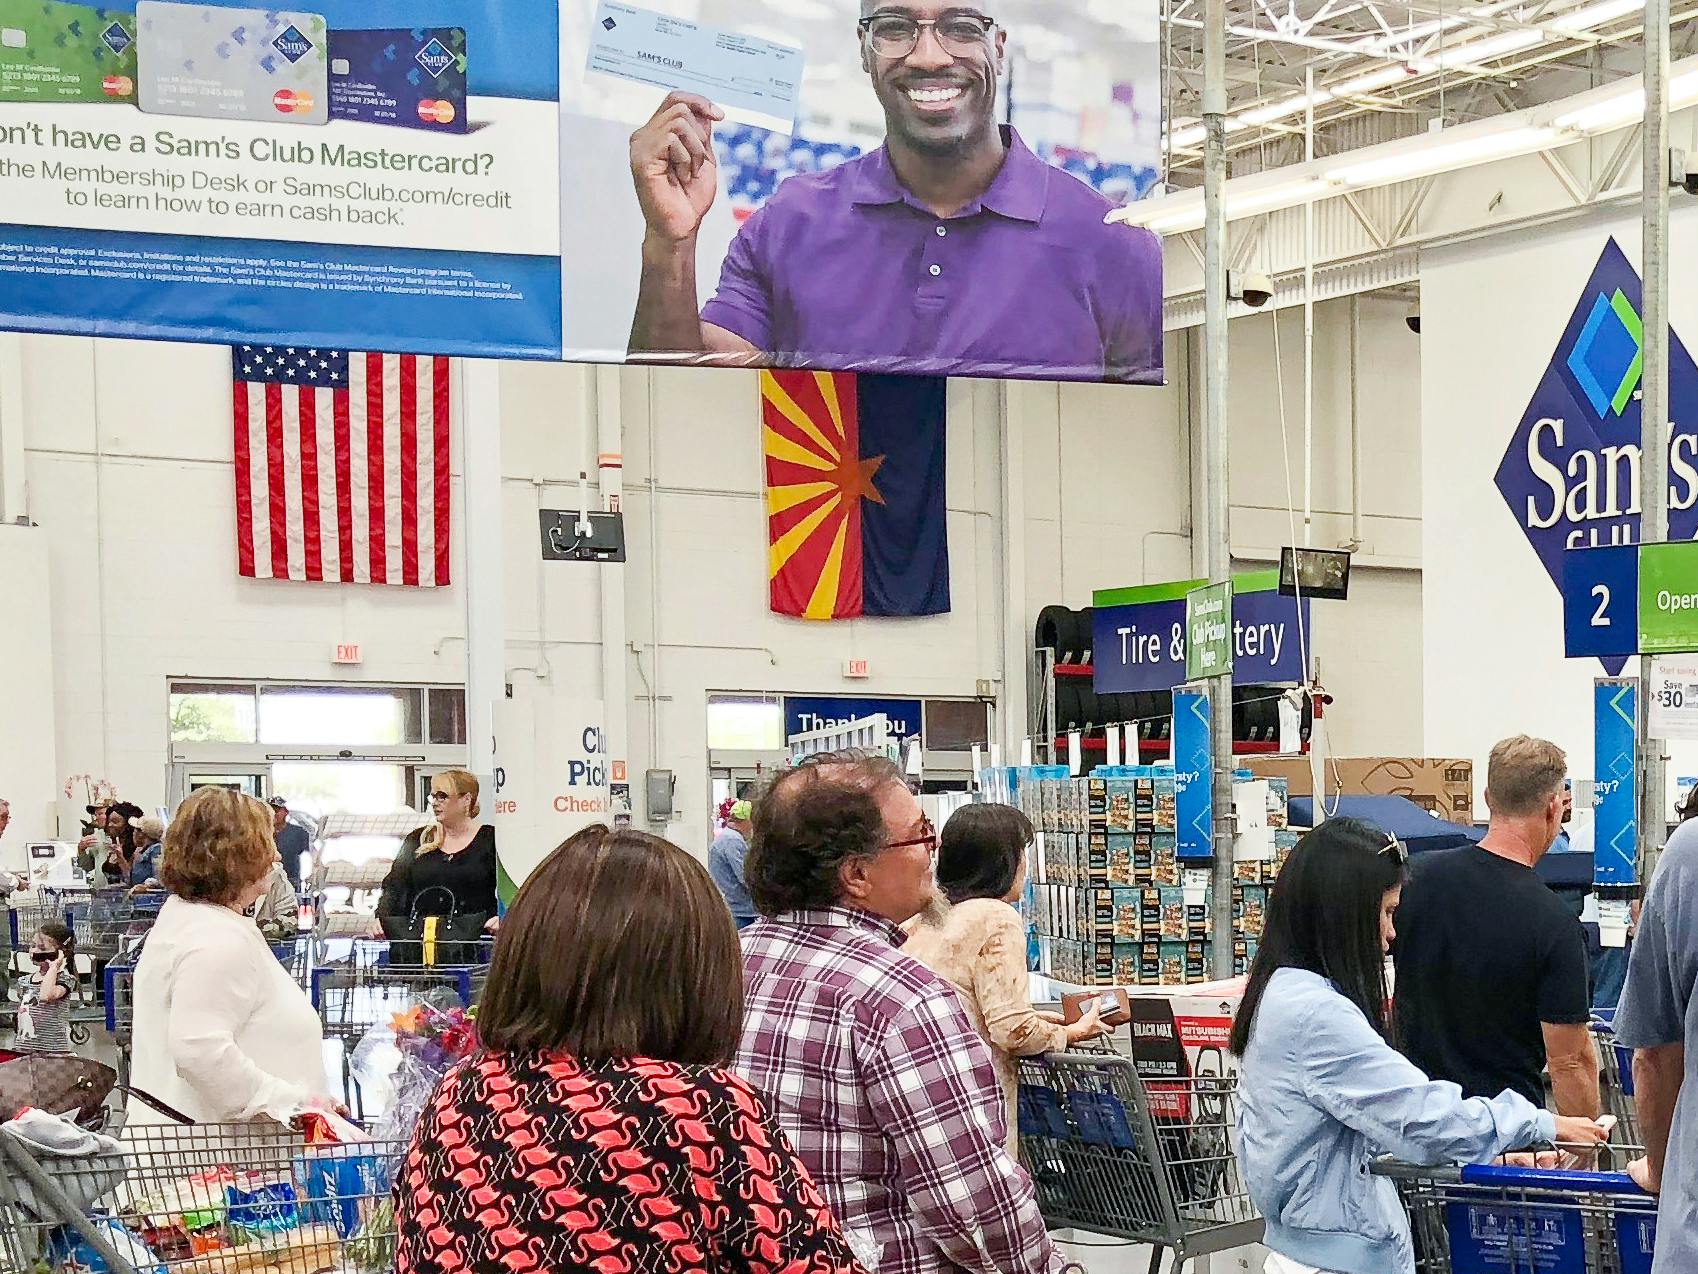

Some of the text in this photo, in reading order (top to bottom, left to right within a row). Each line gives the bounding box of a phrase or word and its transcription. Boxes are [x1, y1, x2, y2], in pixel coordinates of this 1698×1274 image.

[52, 124, 495, 177] have a Sam's Club Mastercard?
[0, 158, 512, 209] the Membership Desk or SamsClub.com/credit
[65, 187, 88, 206] to
[94, 188, 149, 210] learn
[155, 192, 201, 212] how
[207, 197, 230, 215] to
[235, 202, 284, 218] earn
[289, 203, 341, 222] cash
[1589, 584, 1611, 627] 2
[337, 644, 360, 660] EXIT
[1117, 625, 1161, 665] Tire
[1169, 622, 1185, 662] &
[1657, 690, 1683, 708] $30
[1663, 680, 1683, 690] Save
